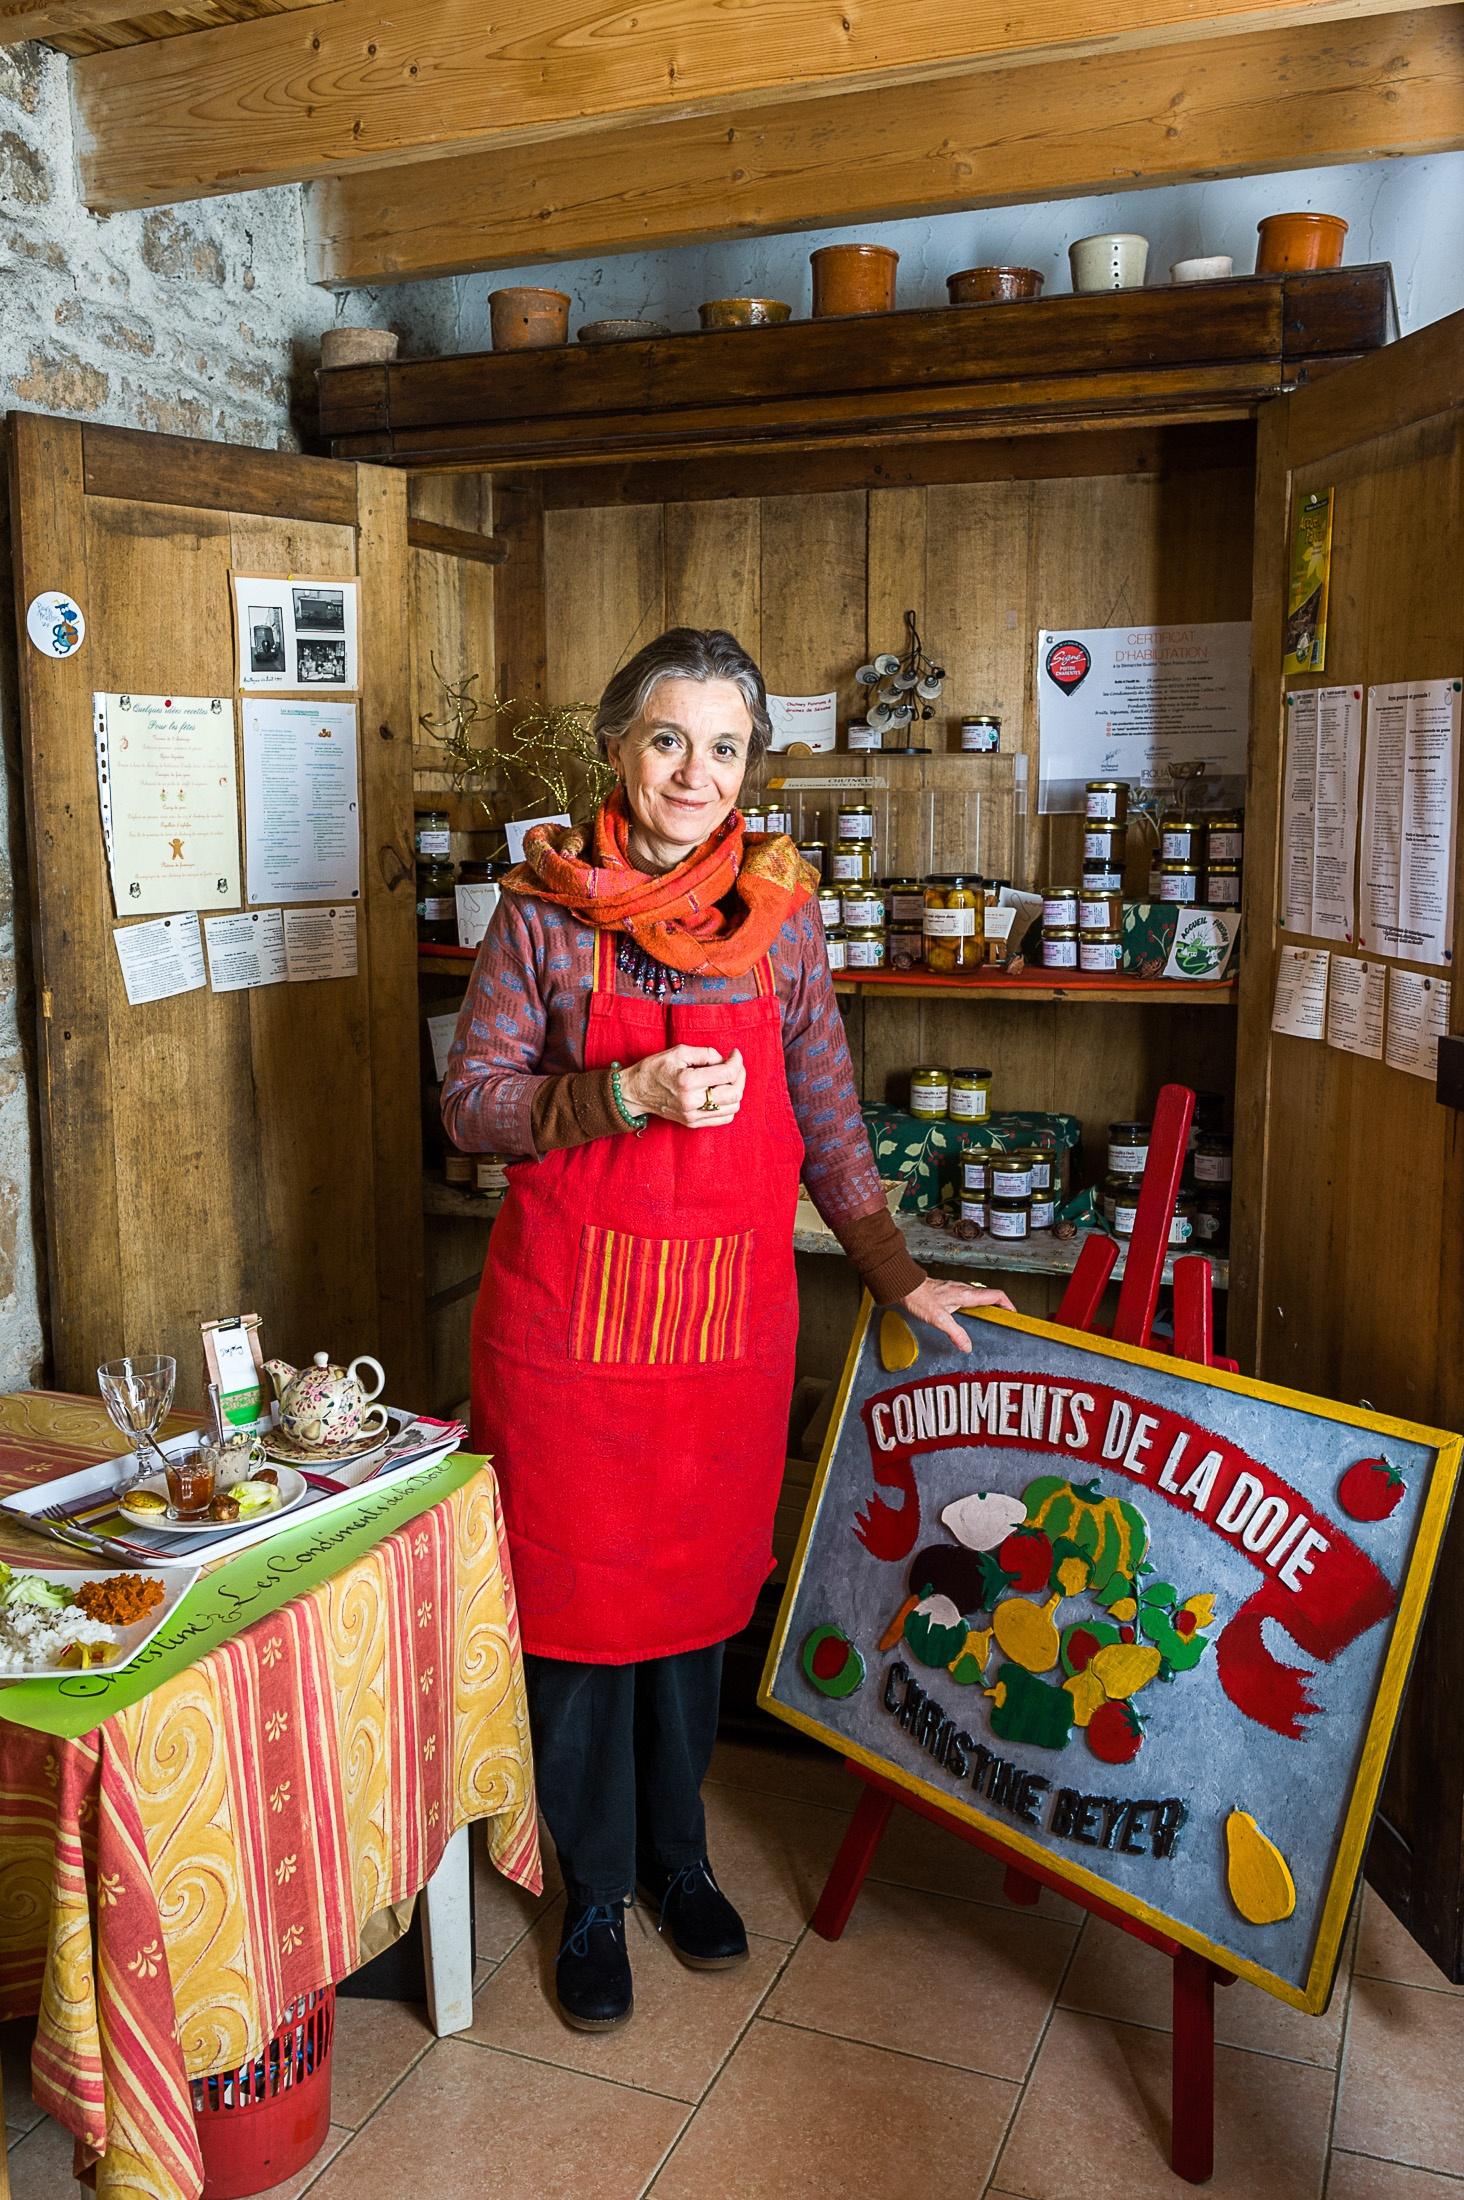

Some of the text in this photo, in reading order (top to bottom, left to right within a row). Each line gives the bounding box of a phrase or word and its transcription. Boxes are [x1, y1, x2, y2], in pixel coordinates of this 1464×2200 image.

[1127, 631, 1195, 645] CERTIFICAT
[1050, 650, 1086, 666] Signé
[1115, 647, 1208, 662] D'HABILITATION
[132, 703, 163, 715] Quelques
[183, 706, 209, 715] recettes
[147, 720, 167, 731] Pour
[168, 721, 178, 731] les
[1181, 916, 1230, 942] ACCUEIL PAYSAN
[871, 1381, 1331, 1593] CONDIMENTS DE LA DOIE
[218, 1574, 280, 1607] Les
[266, 1503, 389, 1573] Condiments
[883, 1661, 1188, 1861] CHRISTINE BEYER
